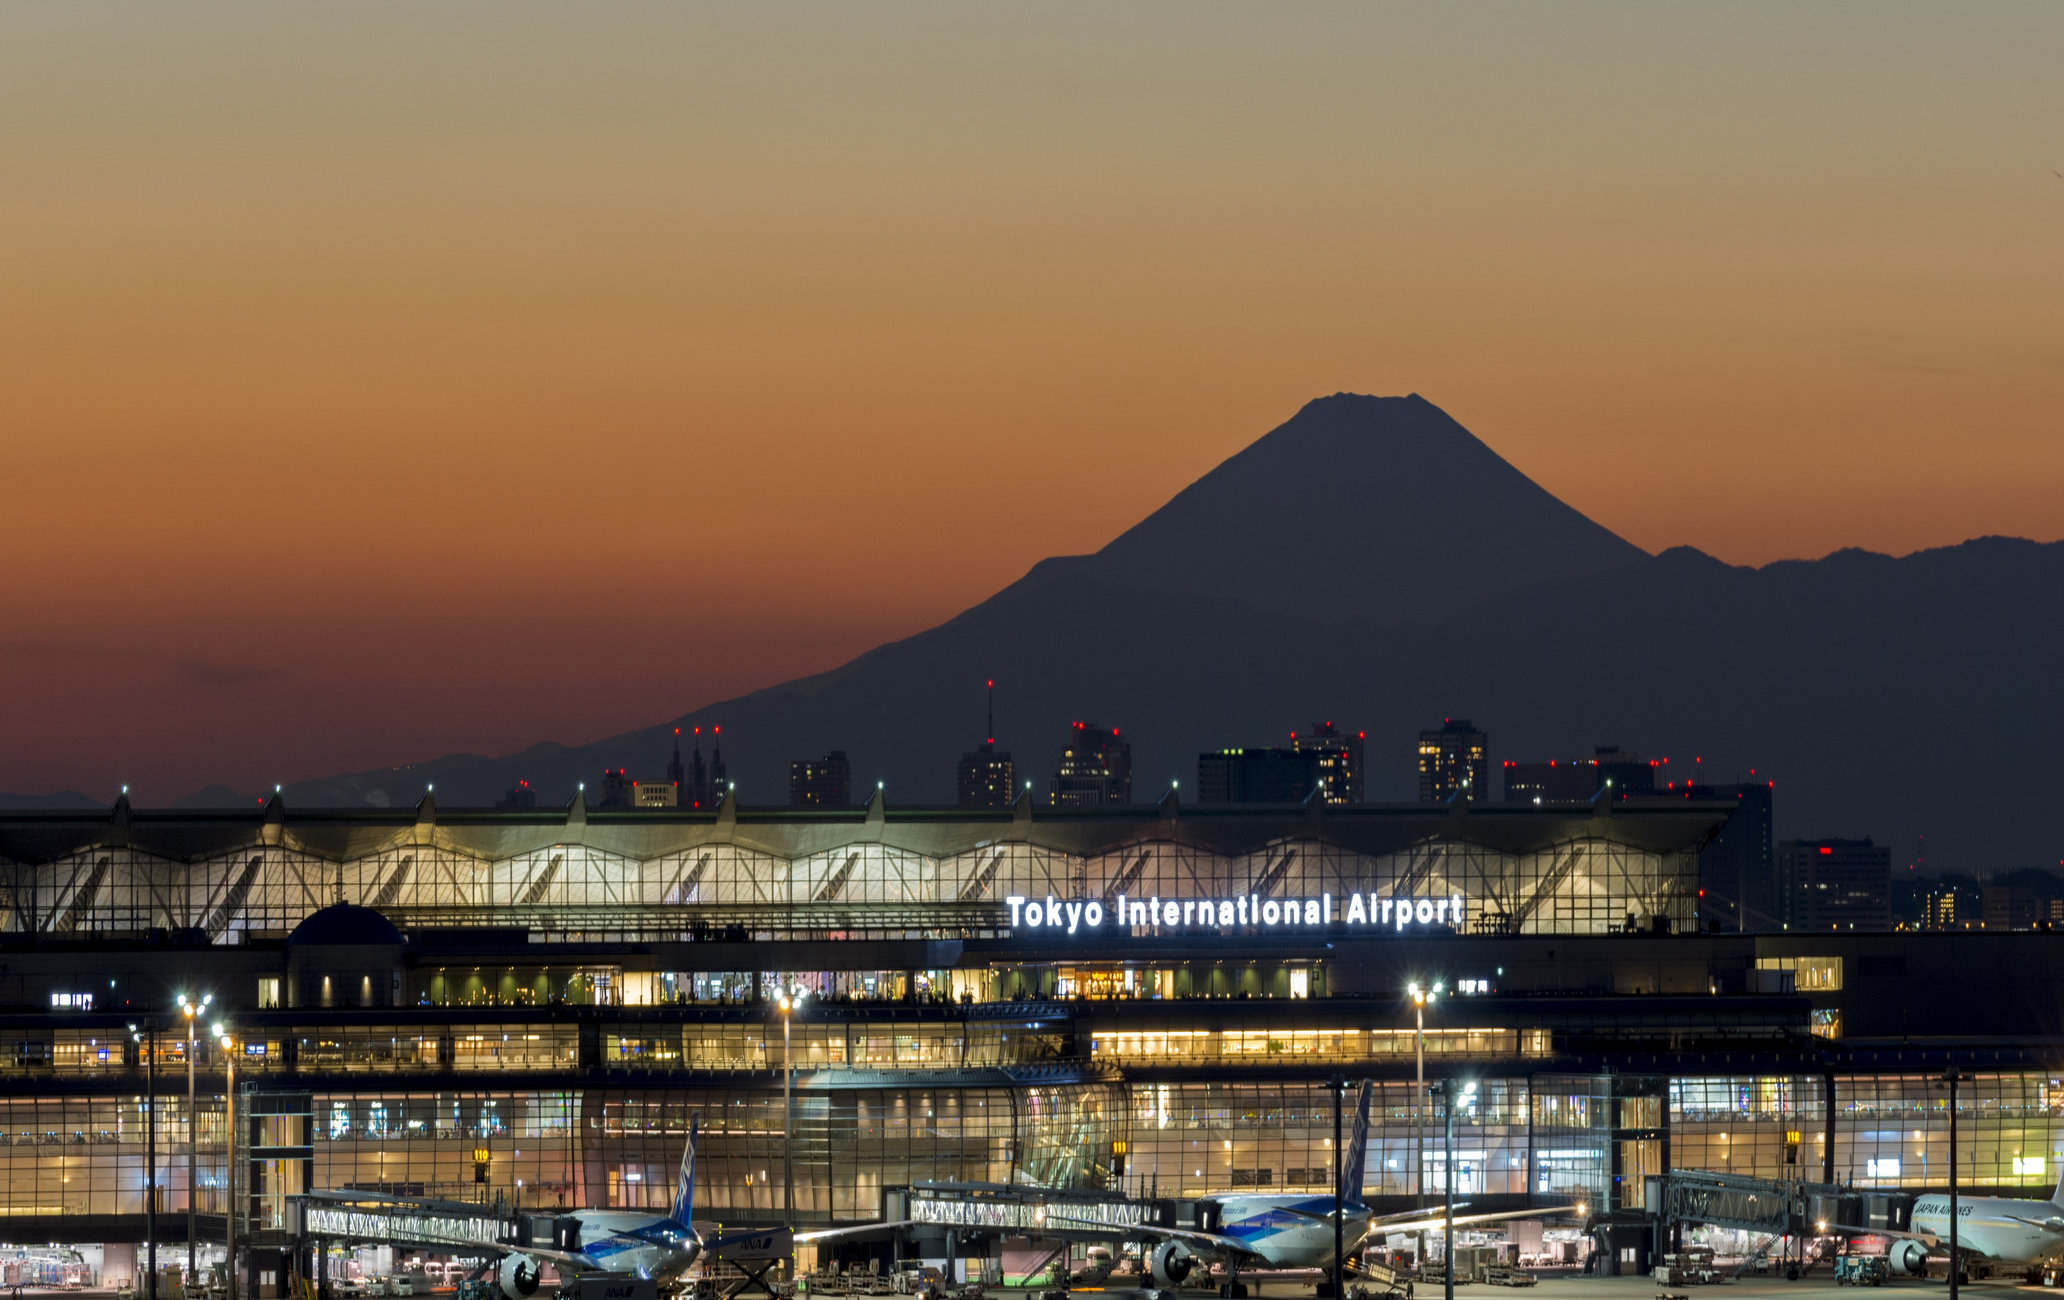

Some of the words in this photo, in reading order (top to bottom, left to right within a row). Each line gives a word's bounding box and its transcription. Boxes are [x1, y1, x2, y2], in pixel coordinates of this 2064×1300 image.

[1006, 896, 1103, 934] Tokyo
[1118, 894, 1331, 927] International
[1346, 893, 1462, 932] Airport
[475, 1149, 489, 1160] 110
[1915, 1203, 1940, 1214] JAPAN
[739, 1239, 762, 1250] ANA
[605, 1287, 625, 1298] ANA
